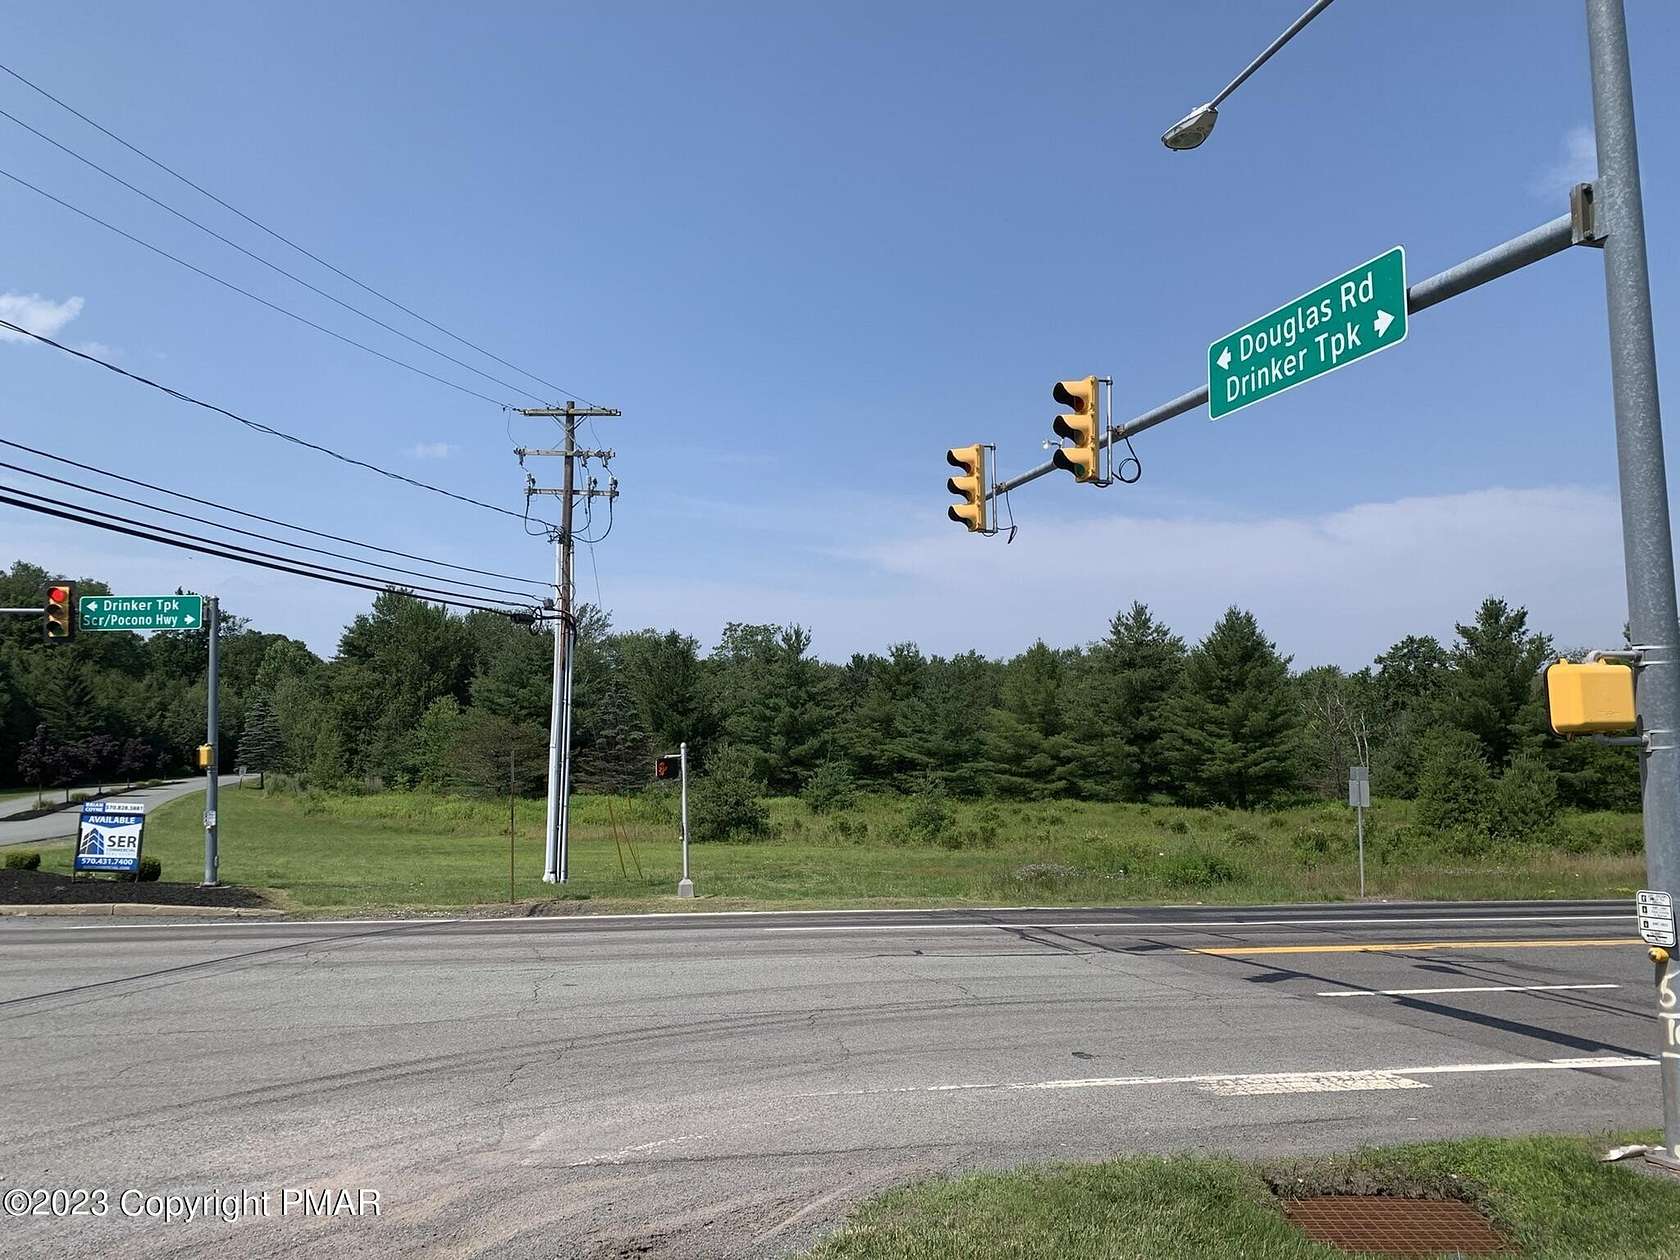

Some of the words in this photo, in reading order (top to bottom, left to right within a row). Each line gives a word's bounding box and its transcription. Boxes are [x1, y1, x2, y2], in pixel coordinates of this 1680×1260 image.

[1239, 298, 1333, 362] Douglas
[1339, 271, 1374, 313] Rd
[1226, 347, 1308, 403] Drinker
[1314, 321, 1362, 364] Tpk
[103, 599, 152, 611] Drinker
[156, 599, 179, 612] Tpk
[83, 614, 152, 627] Scr/Pocono
[156, 614, 178, 628] Hwy
[88, 815, 136, 823] AVAILABLE
[107, 836, 137, 847] SER
